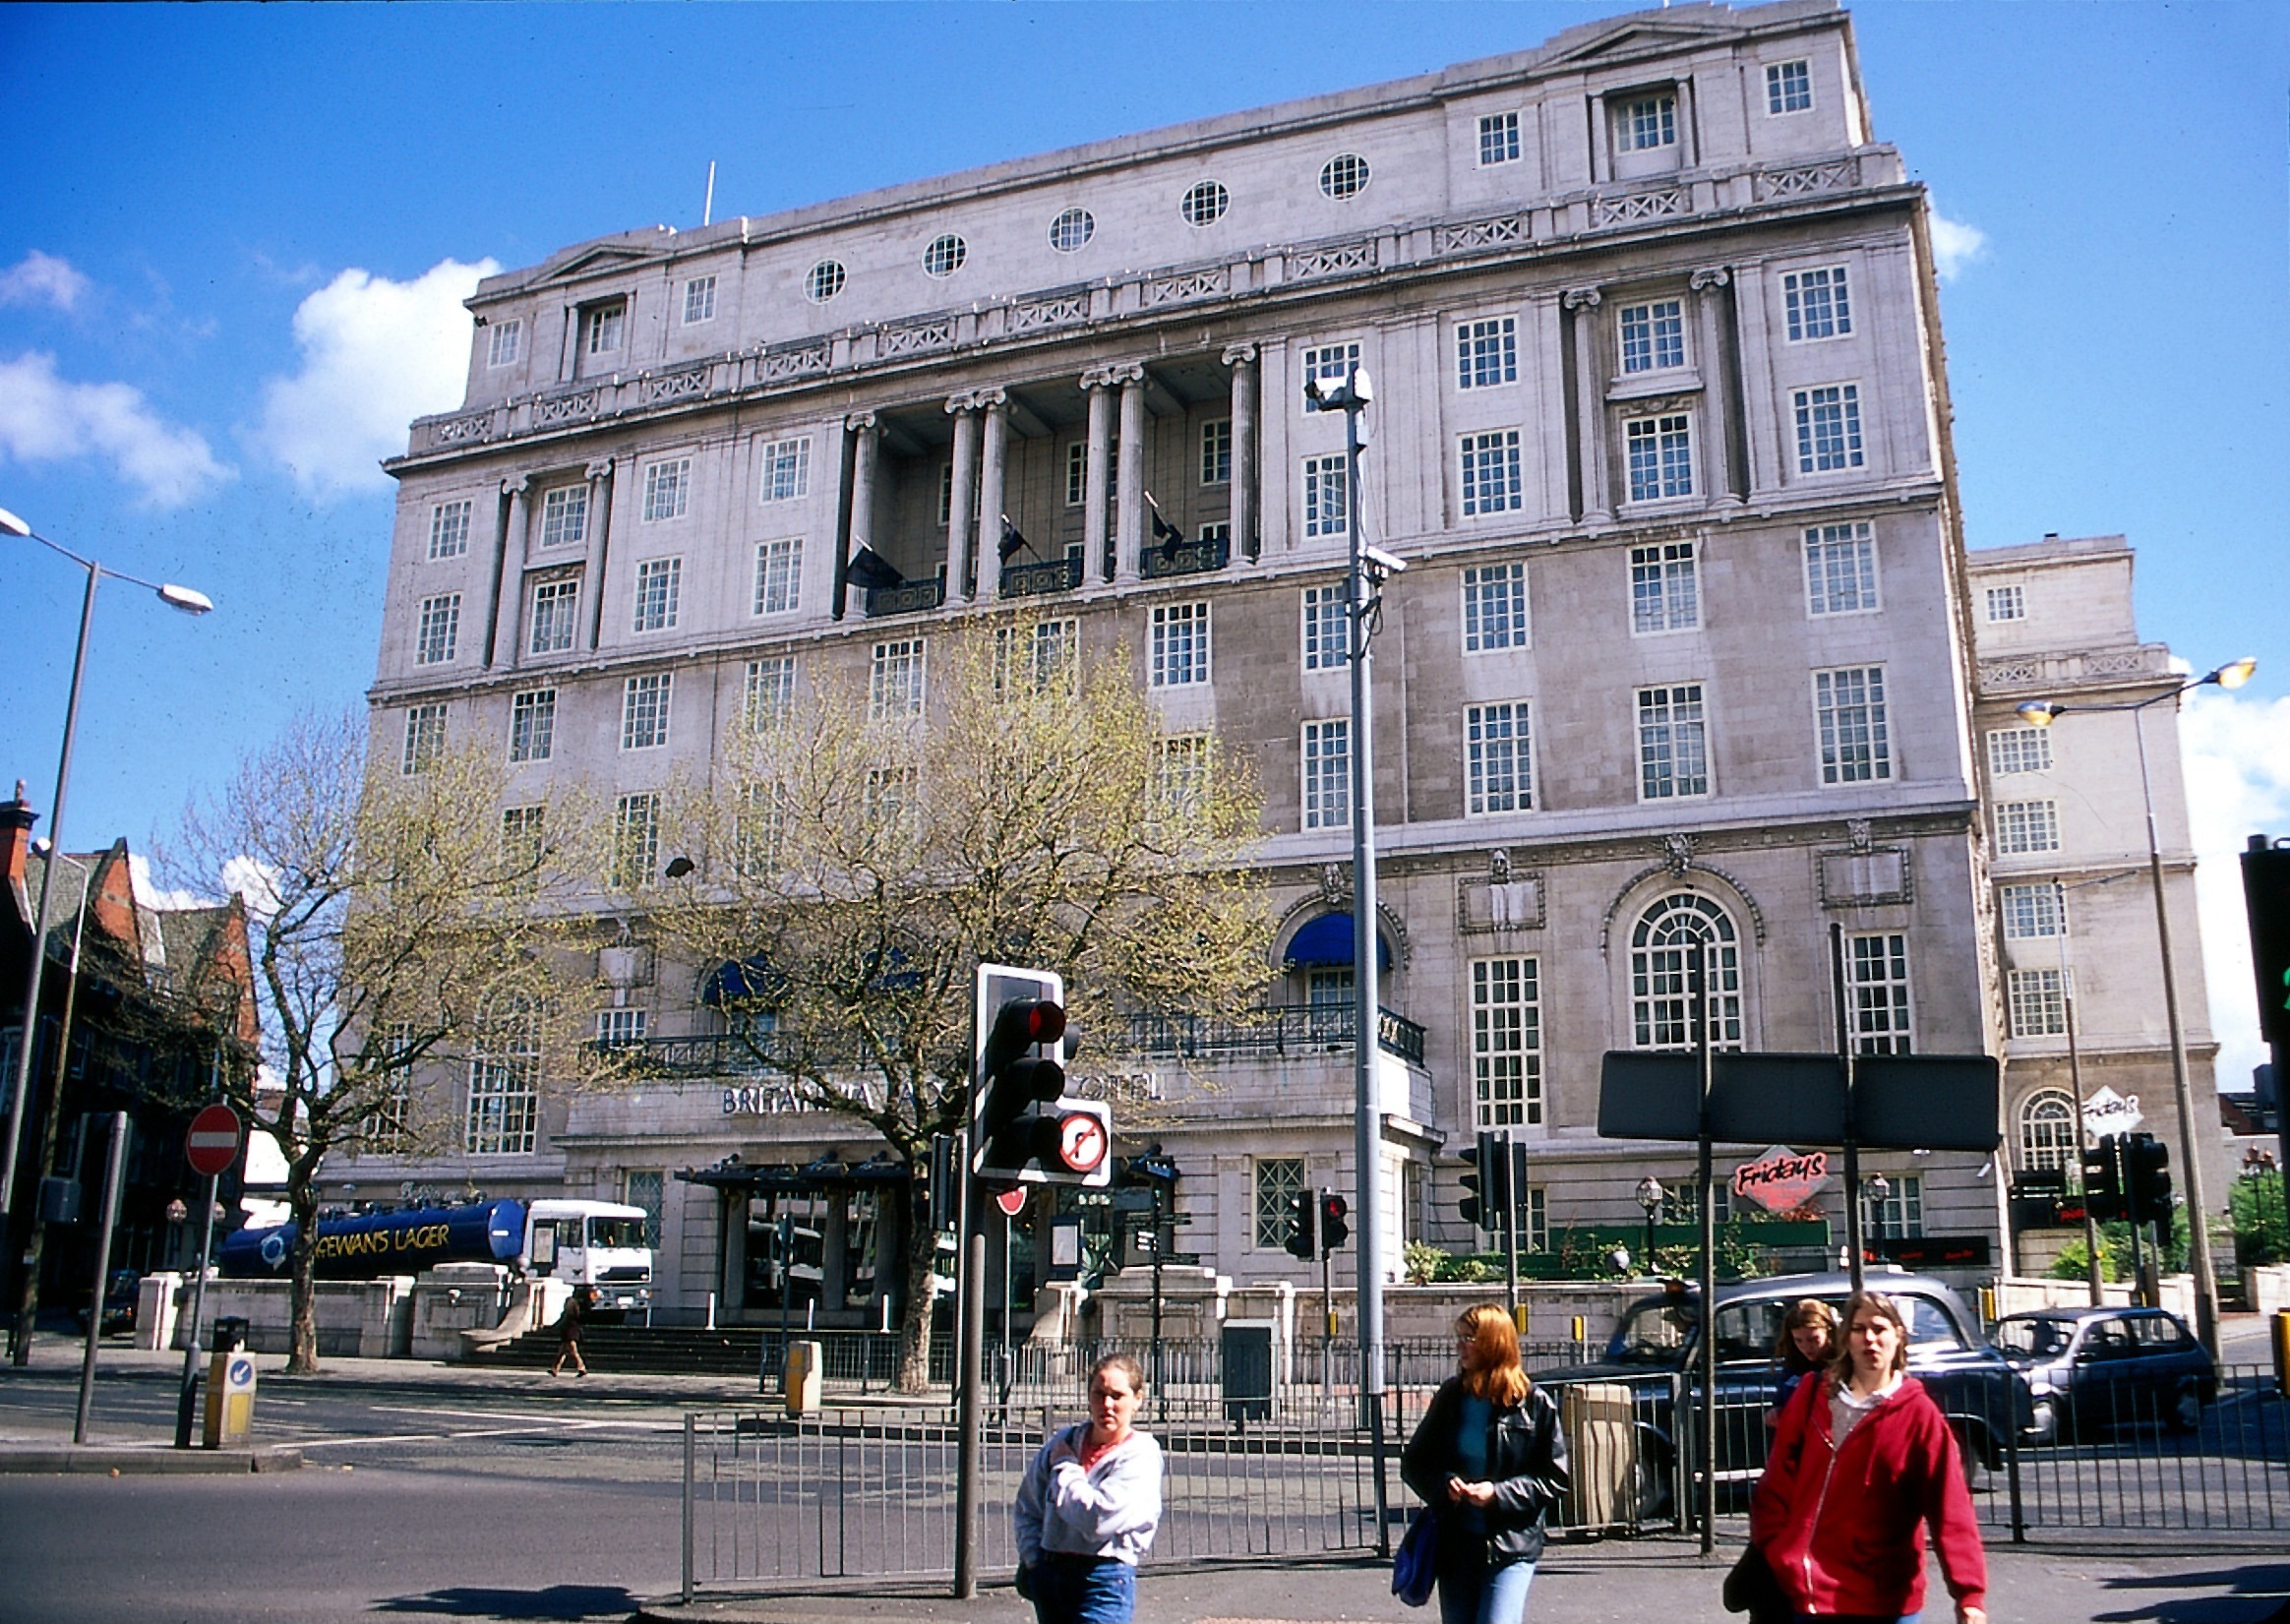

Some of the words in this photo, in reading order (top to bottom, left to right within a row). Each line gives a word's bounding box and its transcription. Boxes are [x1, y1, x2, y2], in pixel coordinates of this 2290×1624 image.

[723, 1083, 875, 1114] BRITANIA
[1079, 1072, 1166, 1101] OTEL
[394, 1224, 450, 1251] LAGER
